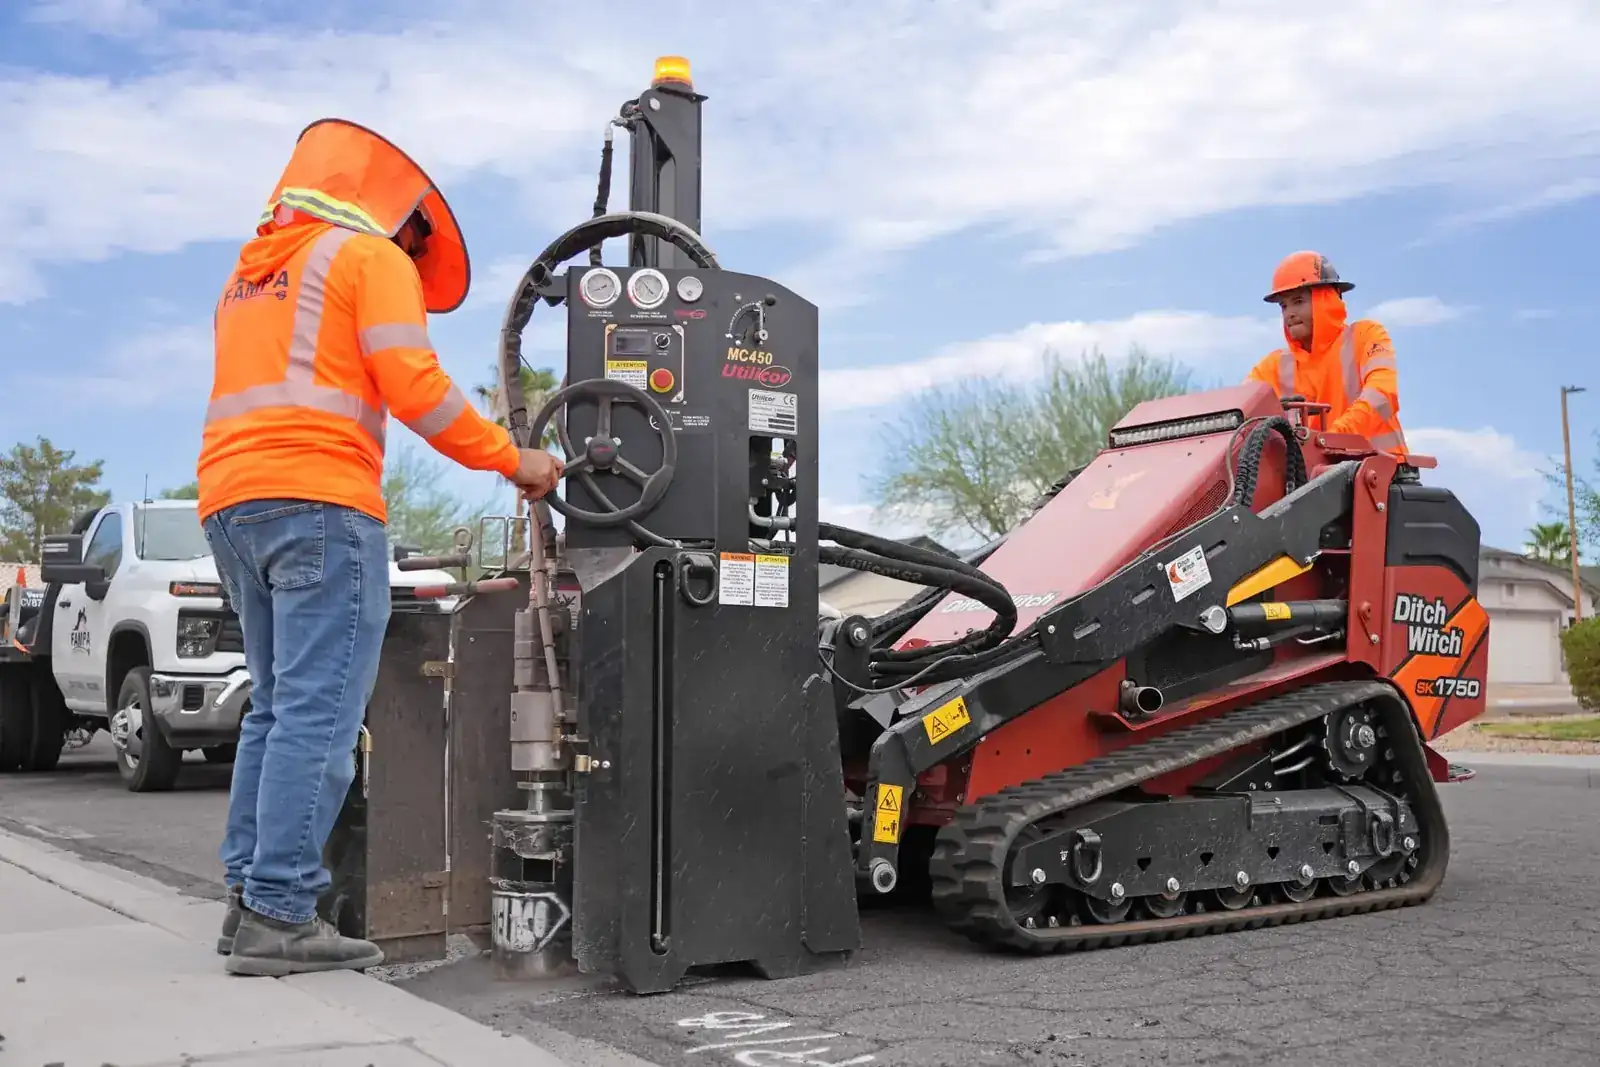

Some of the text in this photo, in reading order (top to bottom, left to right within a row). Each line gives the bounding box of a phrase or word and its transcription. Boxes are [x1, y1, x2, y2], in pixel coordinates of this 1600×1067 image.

[223, 270, 289, 307] FAMPA
[727, 347, 773, 365] MC450
[721, 363, 790, 384] Utilicor
[1394, 595, 1447, 625] Ditch
[70, 631, 91, 648] FAMPA
[1408, 625, 1461, 655] Witch
